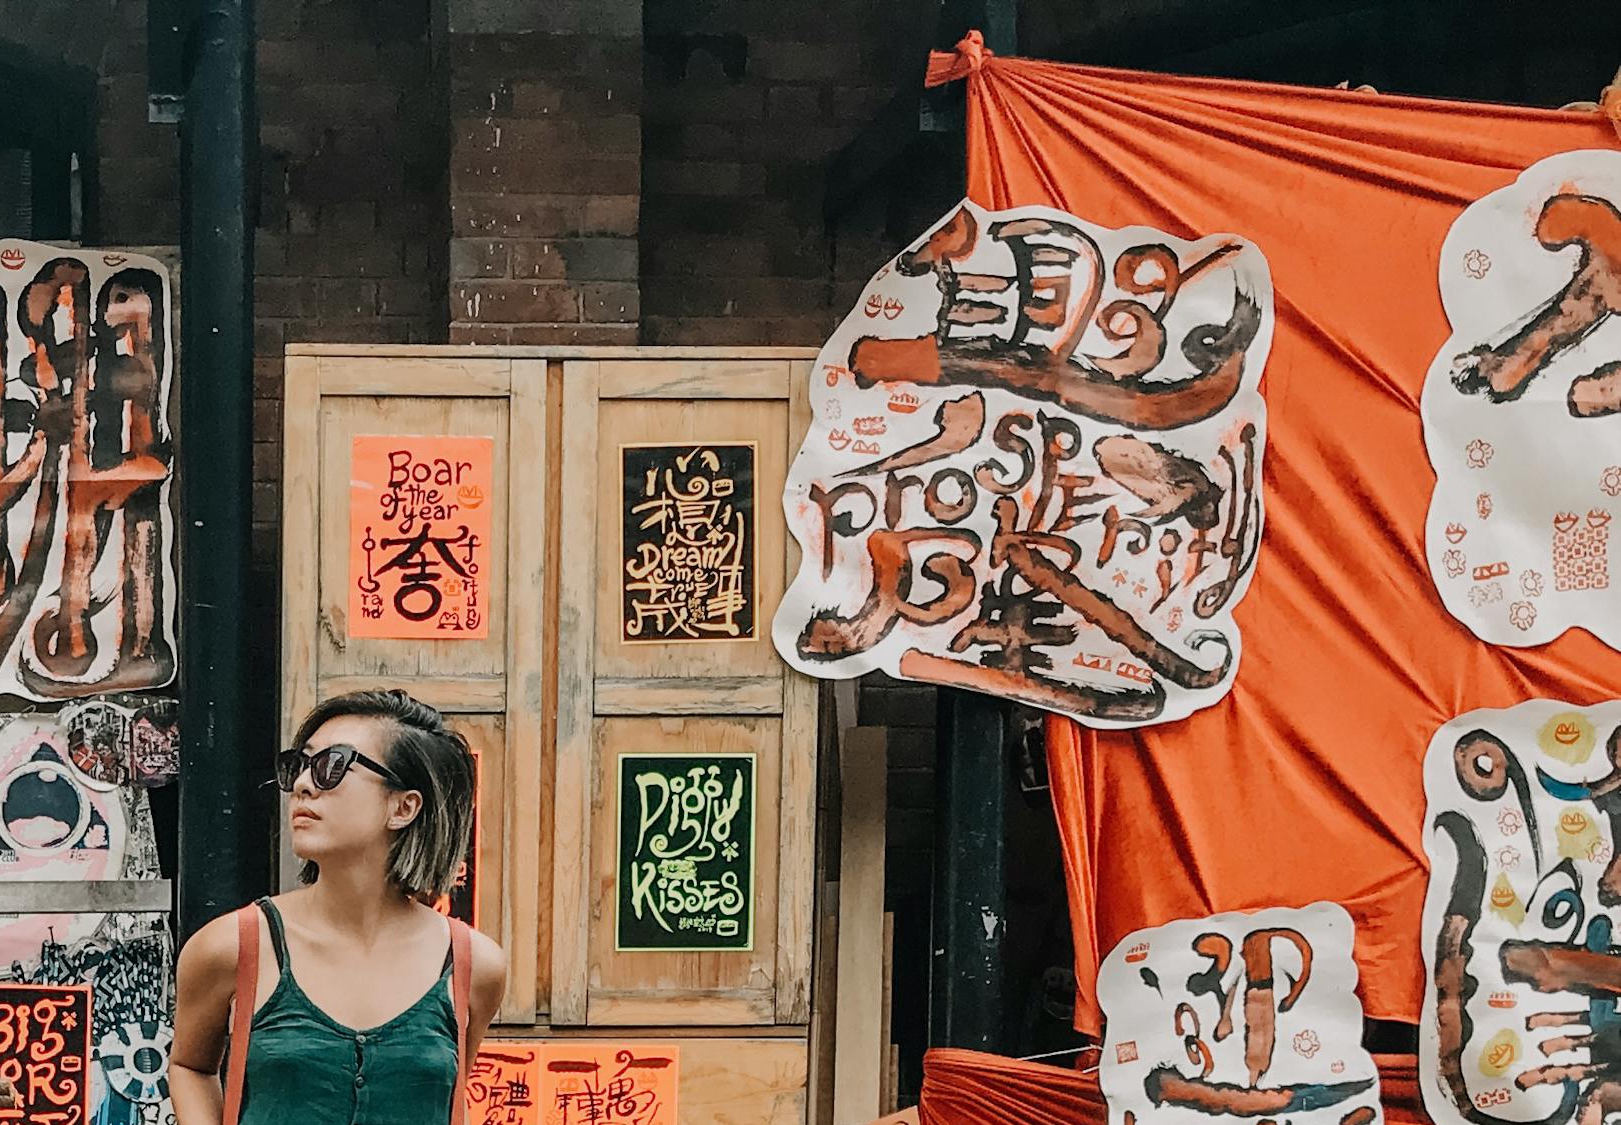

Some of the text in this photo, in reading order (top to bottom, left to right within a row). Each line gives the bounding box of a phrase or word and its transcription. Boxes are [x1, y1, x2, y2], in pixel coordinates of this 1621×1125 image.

[388, 450, 472, 488] Boar
[380, 484, 443, 520] of the
[399, 504, 459, 534] year
[626, 532, 736, 579] Dream
[653, 566, 712, 583] come
